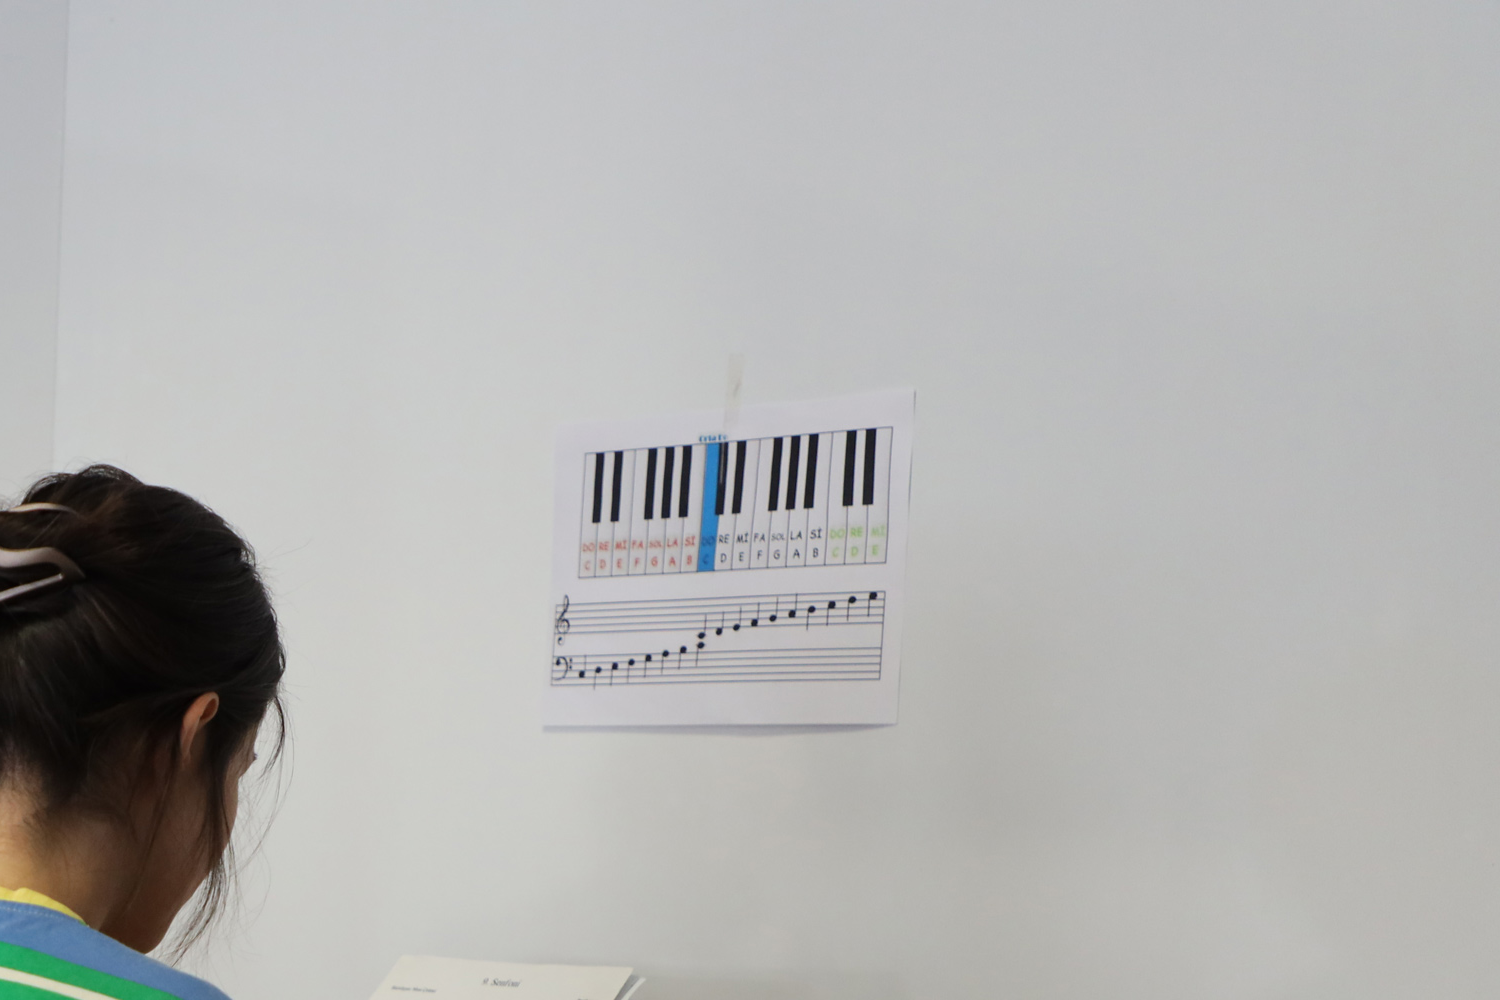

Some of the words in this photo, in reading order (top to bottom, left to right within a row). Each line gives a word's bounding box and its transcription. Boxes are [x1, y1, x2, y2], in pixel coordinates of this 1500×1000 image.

[718, 534, 730, 544] RE
[753, 532, 766, 542] FA
[770, 532, 786, 542] SOL
[790, 530, 802, 540] LA
[720, 552, 727, 564] D
[738, 552, 744, 562] E
[756, 550, 763, 560] F
[774, 550, 780, 560] G
[792, 548, 800, 560] A
[812, 548, 818, 558] B
